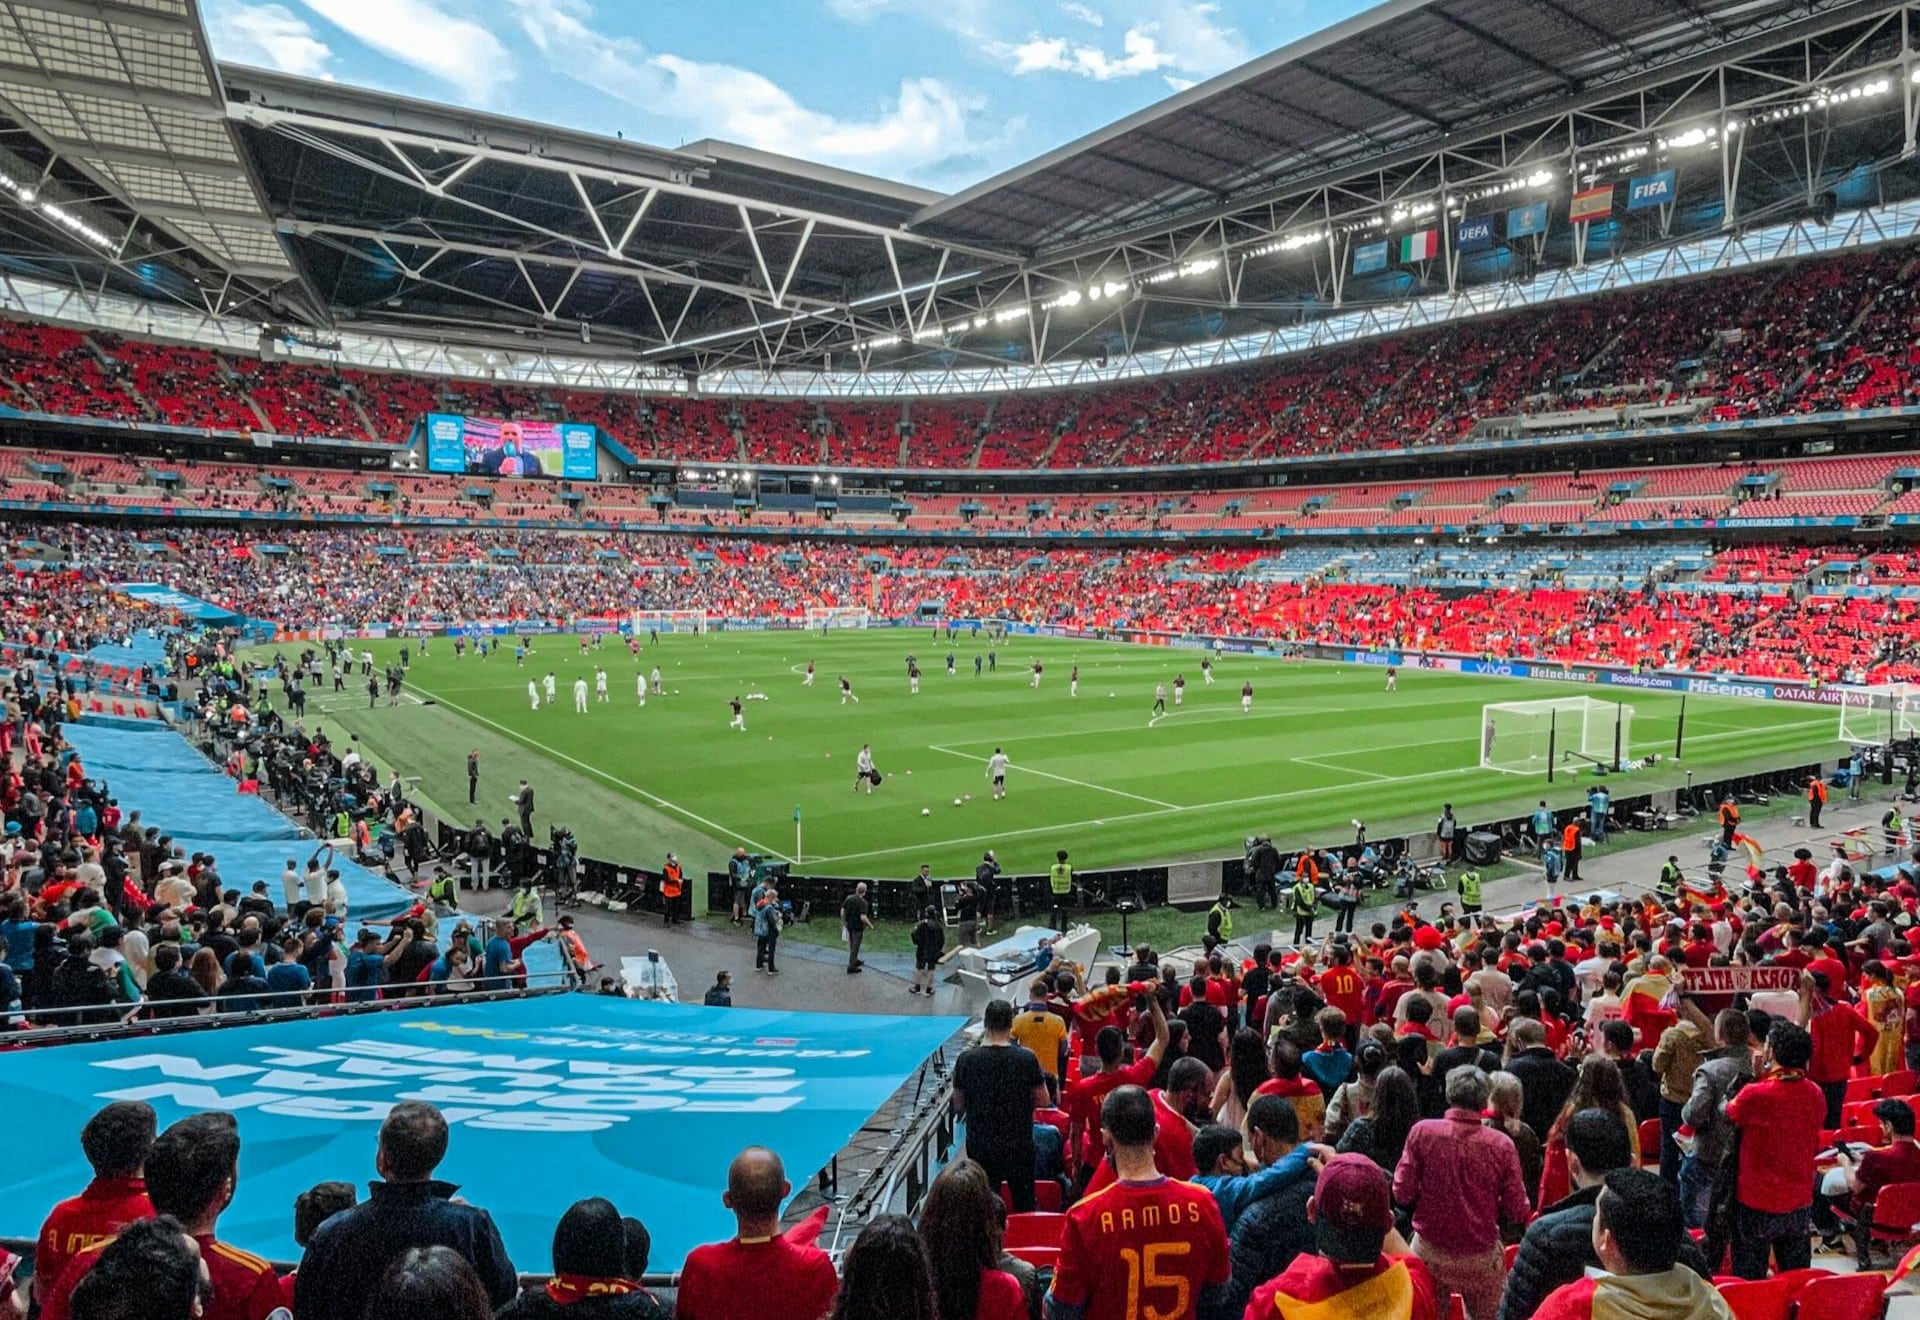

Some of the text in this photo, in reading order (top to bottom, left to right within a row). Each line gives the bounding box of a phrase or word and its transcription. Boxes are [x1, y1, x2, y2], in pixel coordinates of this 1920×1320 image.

[1634, 181, 1667, 200] FIFA
[1460, 225, 1488, 240] UEFA
[1725, 518, 1794, 527] UEFA EURO 2020
[1530, 667, 1585, 681] Heineken
[1611, 672, 1672, 688] Booking.com
[1688, 679, 1766, 698] Hisense
[1773, 687, 1816, 701] QATAR
[1336, 975, 1353, 994] 10
[316, 1039, 796, 1079] GAME
[248, 1046, 806, 1094] EQUAL
[88, 1053, 807, 1113] FOR AN
[93, 1082, 631, 1132] SIGN
[1101, 1201, 1200, 1234] RAMOS
[1120, 1242, 1191, 1320] 15
